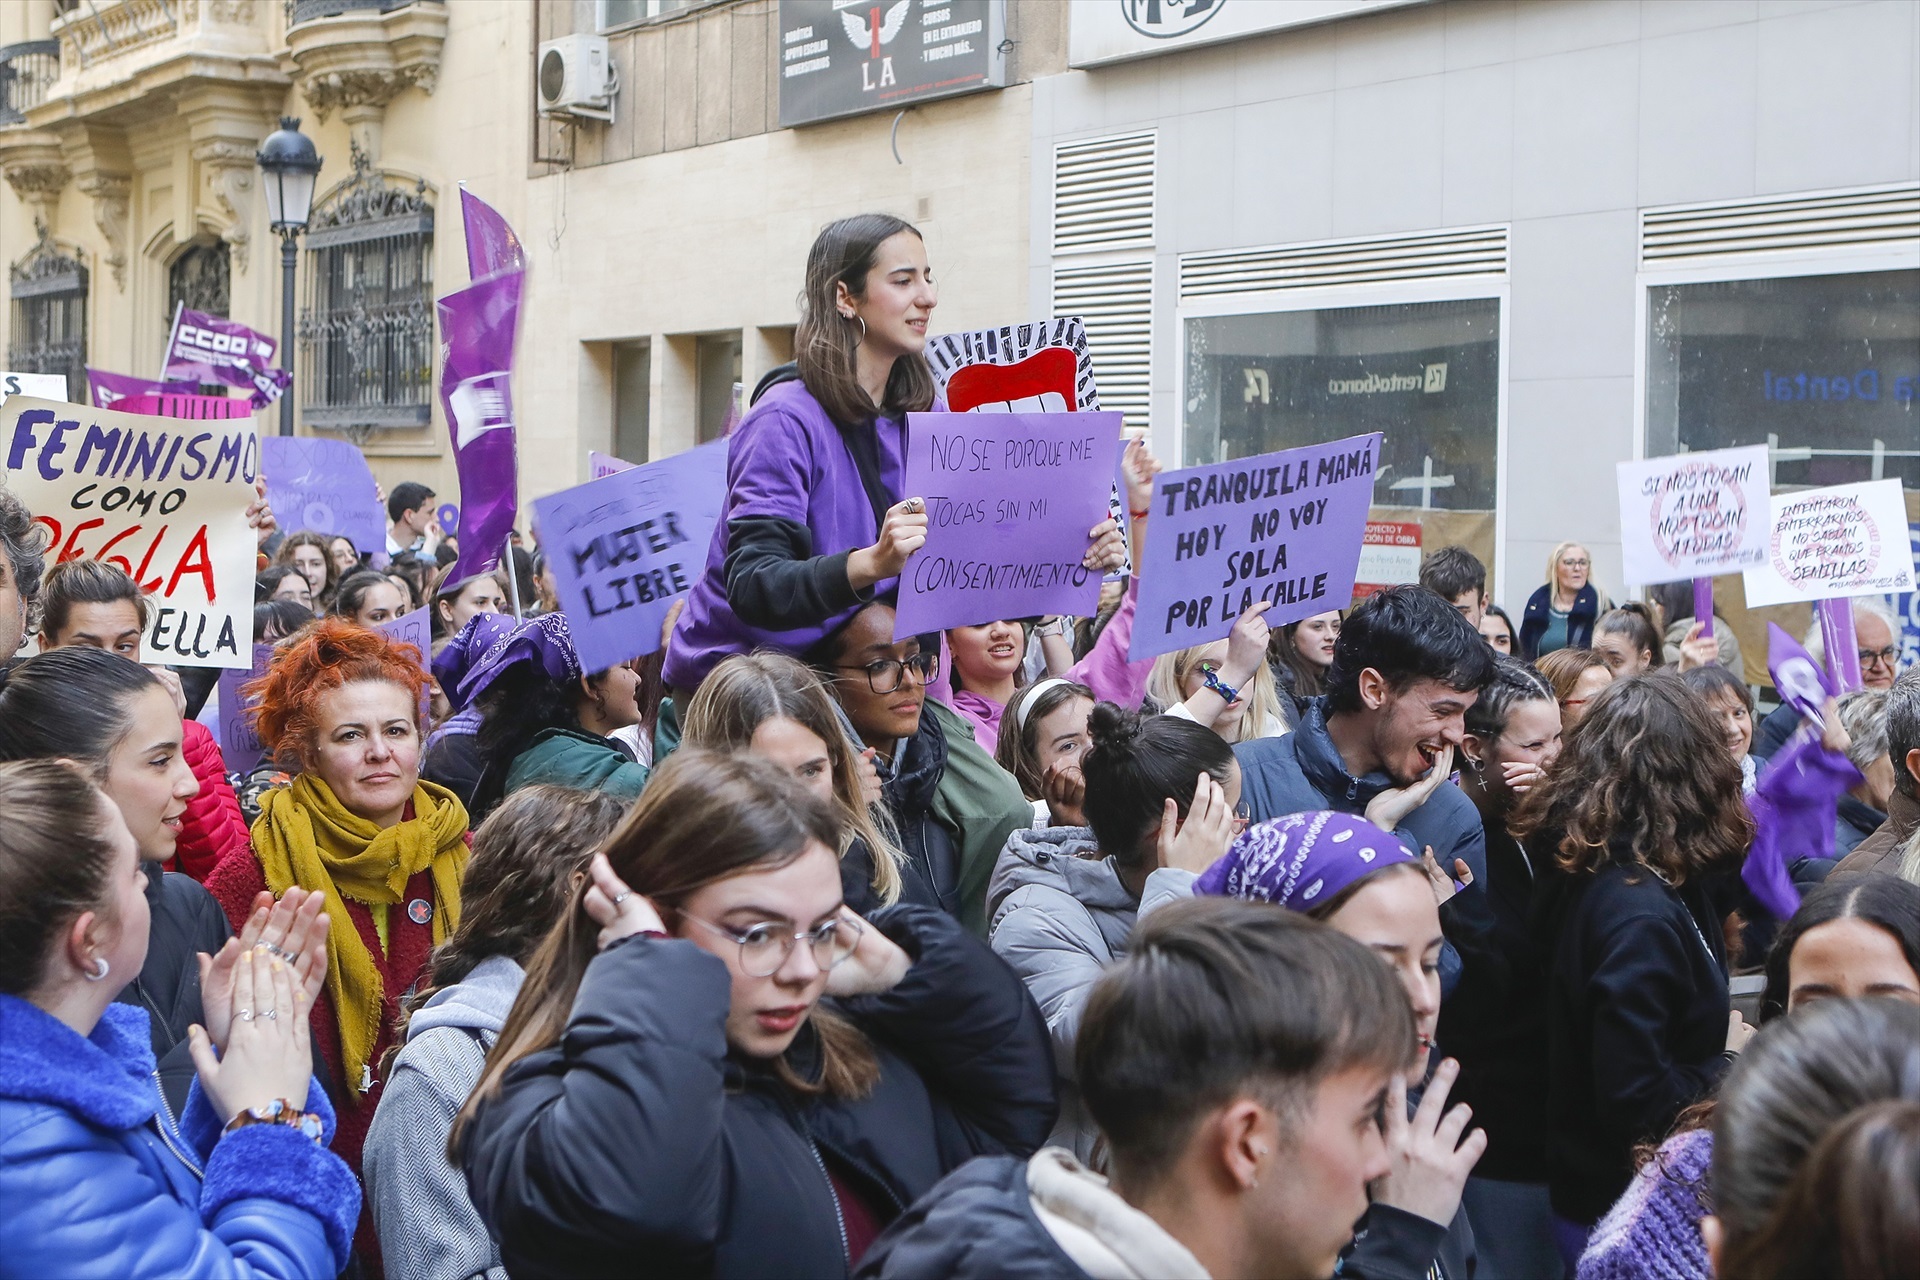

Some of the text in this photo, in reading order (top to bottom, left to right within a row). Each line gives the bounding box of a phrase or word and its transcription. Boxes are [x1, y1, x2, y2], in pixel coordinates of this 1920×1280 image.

[178, 324, 248, 355] CCOO
[7, 409, 257, 484] FEMINISMO
[1005, 439, 1064, 470] PORQUE
[1069, 437, 1095, 462] ME
[1161, 438, 1373, 517] TRANQUILA MAMÁ
[1641, 462, 1751, 496] SI NOS TOCAN
[71, 484, 187, 517] COMO
[927, 496, 1048, 528] TOCAS SIN MI
[1673, 494, 1685, 513] A
[1780, 494, 1859, 518] INTENTARON
[1175, 498, 1328, 561] HOY NO VOY
[1397, 525, 1403, 533] Y
[1657, 506, 1743, 537] NOS TOCAN
[571, 511, 692, 579] MUJER
[1363, 533, 1417, 545] CIÓN DE OBRA
[1668, 537, 1680, 560] A
[1683, 531, 1733, 556] TODAS
[1788, 547, 1812, 563] QUE
[1792, 532, 1809, 547] NO
[914, 555, 1089, 593] CONSENTIMIENTO
[1222, 544, 1287, 588] SOLA
[1790, 559, 1868, 581] SEMILLAS
[580, 562, 691, 618] LIBRE
[1165, 572, 1328, 634] POR LA CALLE
[151, 608, 237, 658] ELLA
